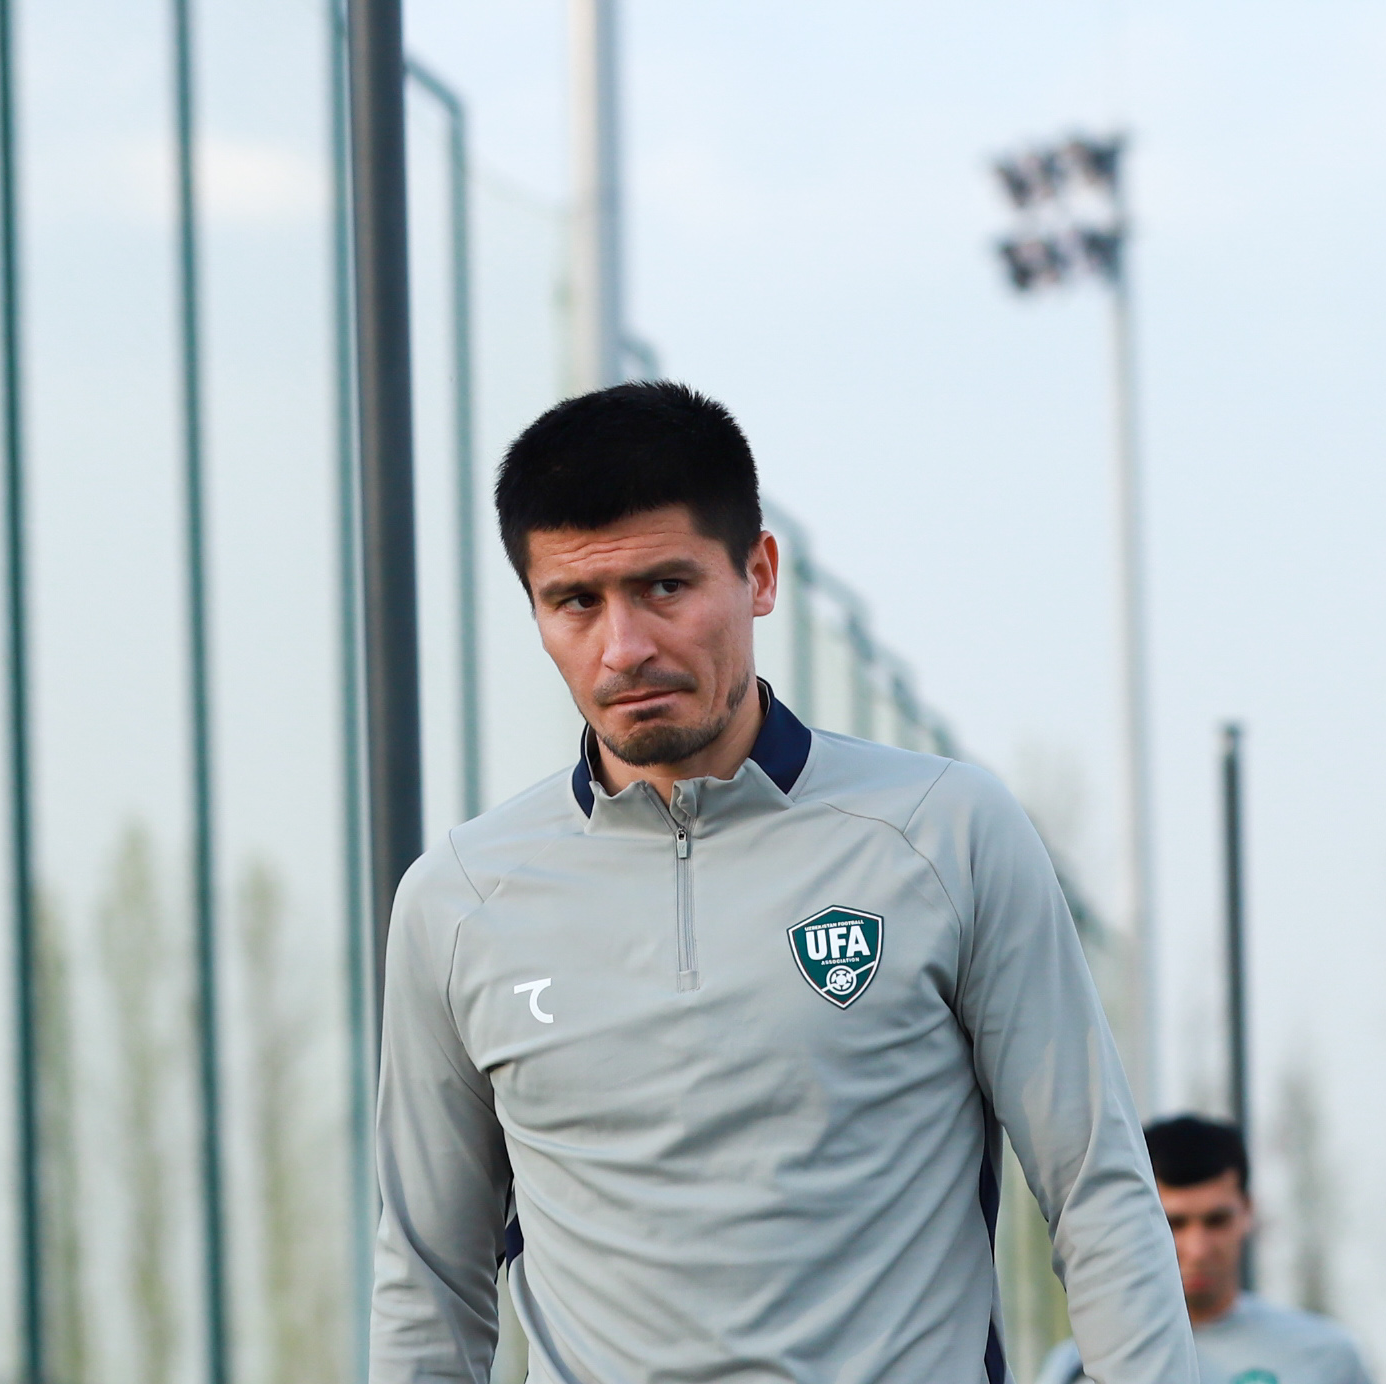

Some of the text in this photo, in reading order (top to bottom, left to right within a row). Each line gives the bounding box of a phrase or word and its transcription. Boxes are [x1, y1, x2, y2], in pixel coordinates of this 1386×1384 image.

[804, 919, 864, 931] UZBEKISTAN FOOTBALL
[805, 925, 871, 960] UFA
[820, 957, 860, 966] ASSOCIATION
